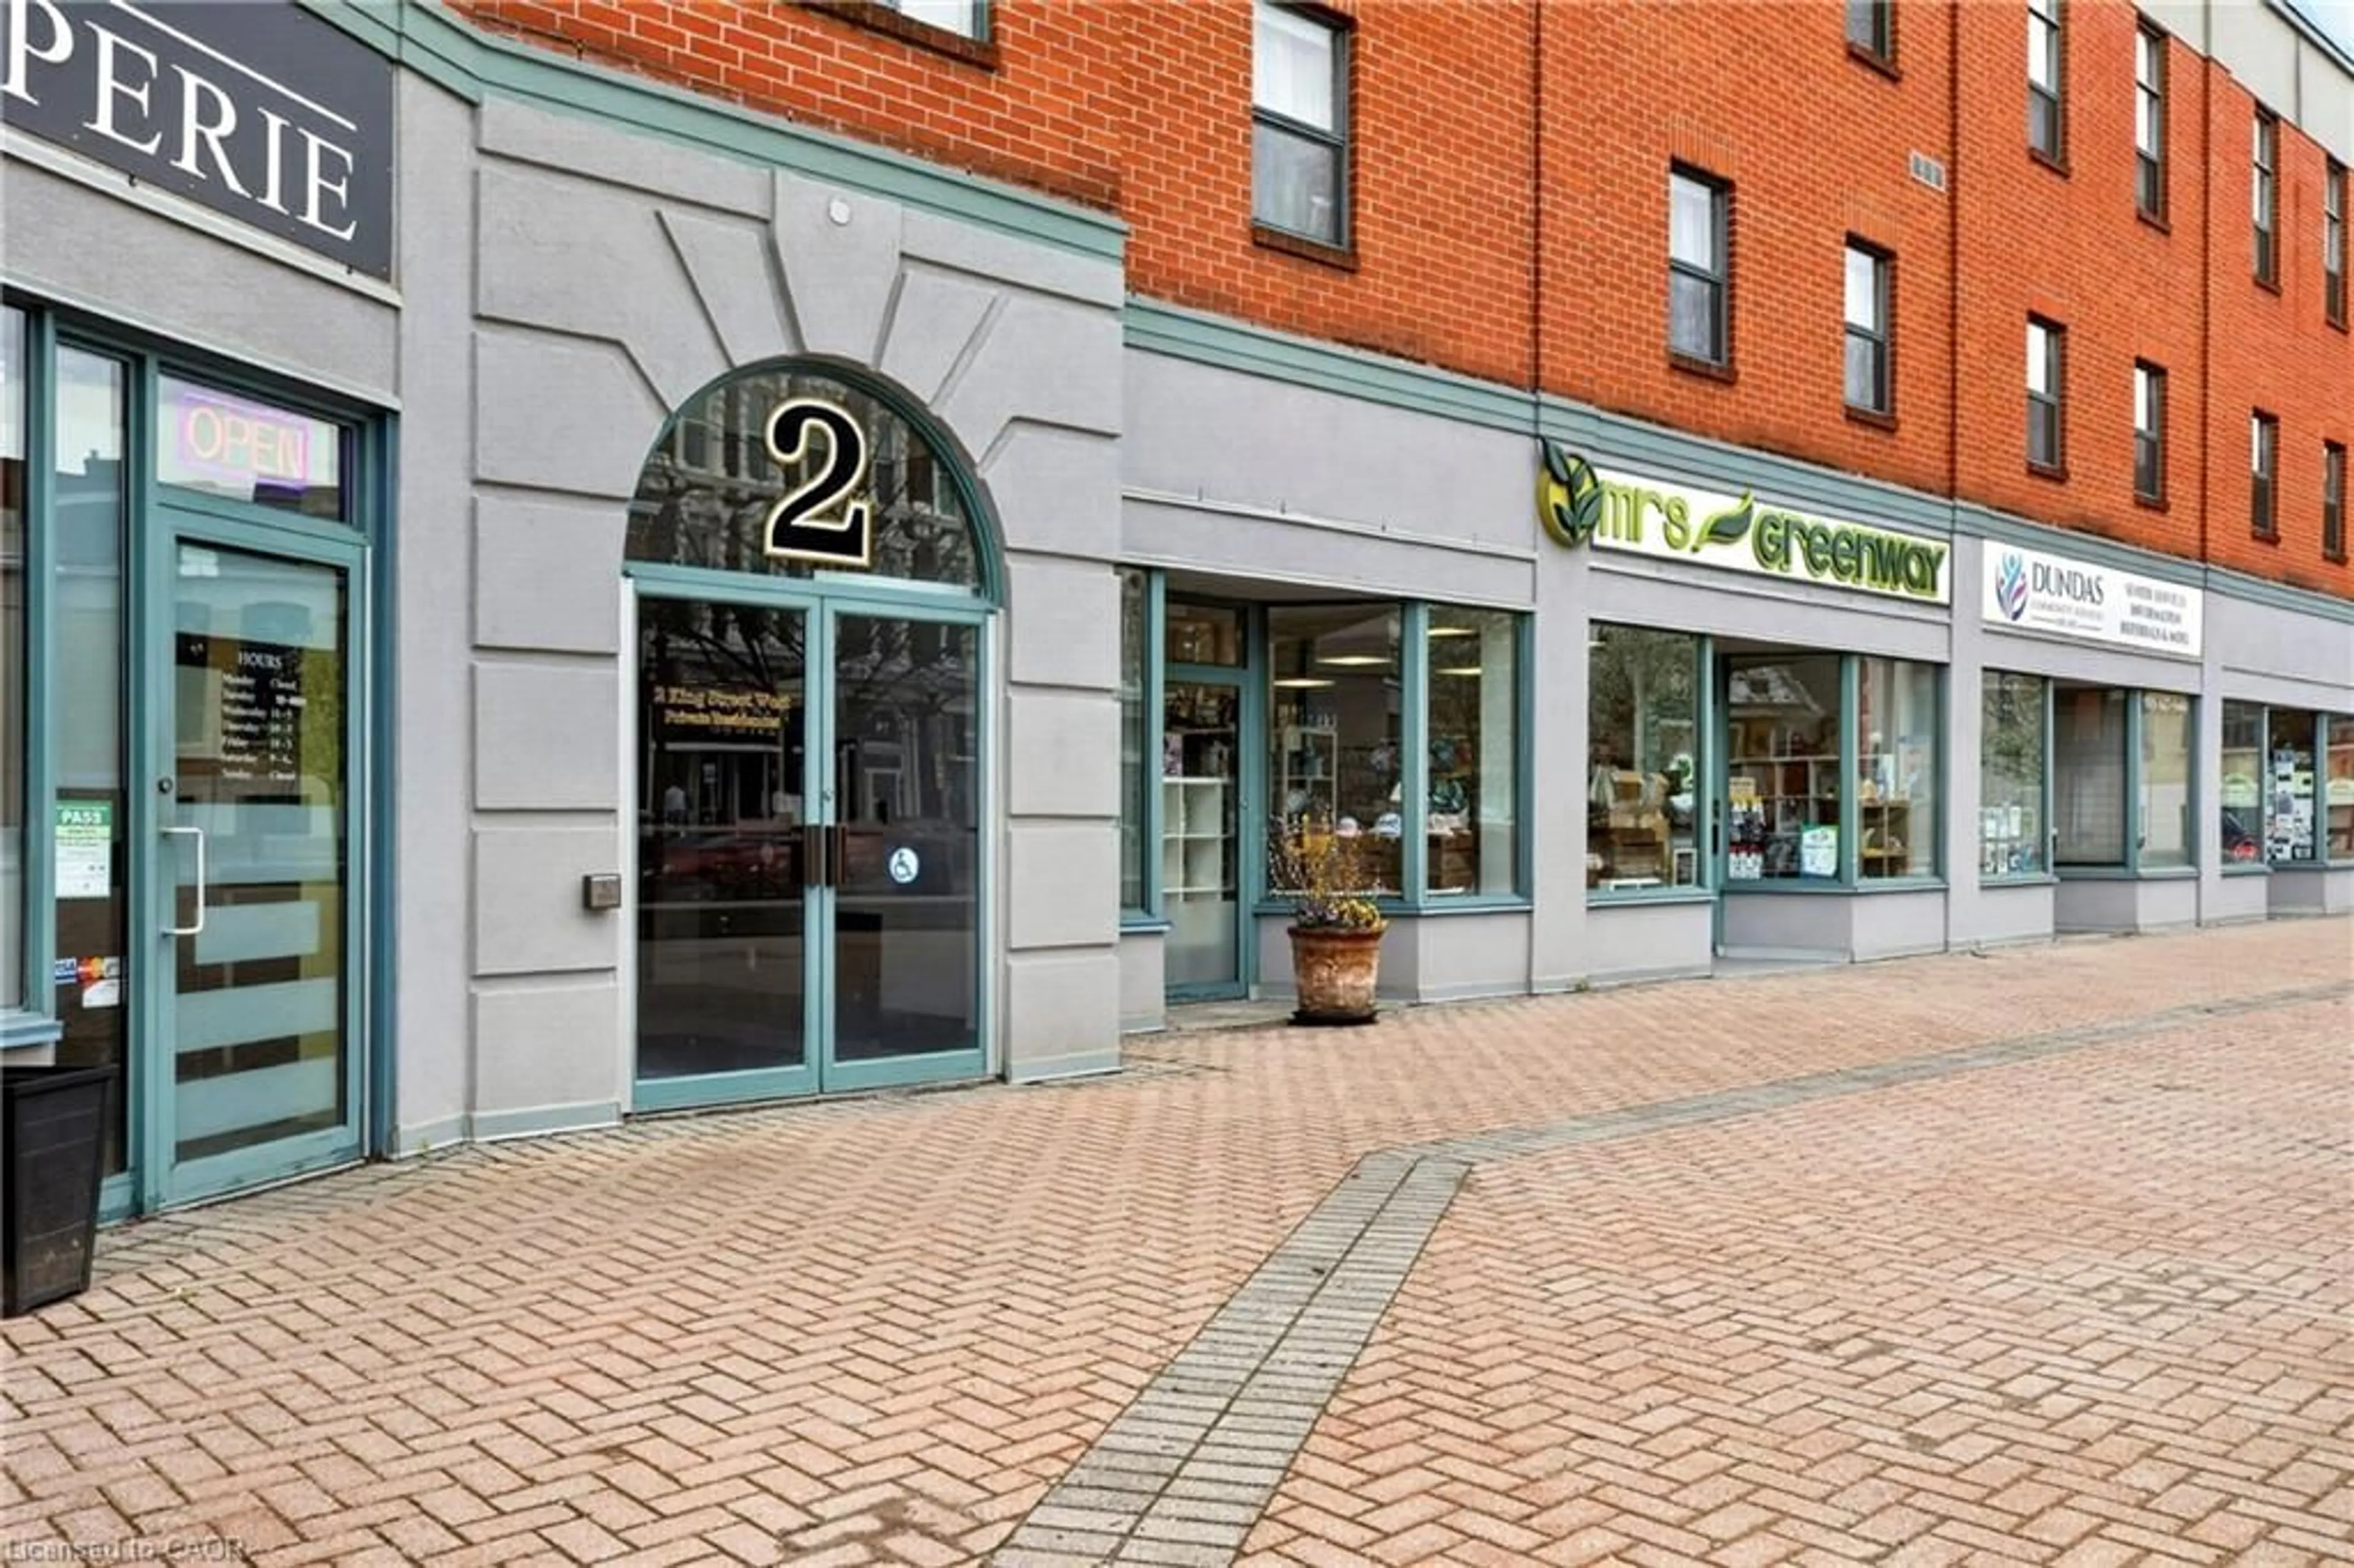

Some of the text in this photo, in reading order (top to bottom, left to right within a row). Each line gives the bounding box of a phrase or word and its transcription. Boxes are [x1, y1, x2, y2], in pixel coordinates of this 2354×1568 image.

[0, 0, 357, 241] PERIE
[188, 406, 303, 479] OPEN
[764, 398, 870, 565] 2
[2032, 560, 2105, 606] DUNDAS
[238, 651, 283, 669] HOURS
[62, 810, 102, 825] PASS
